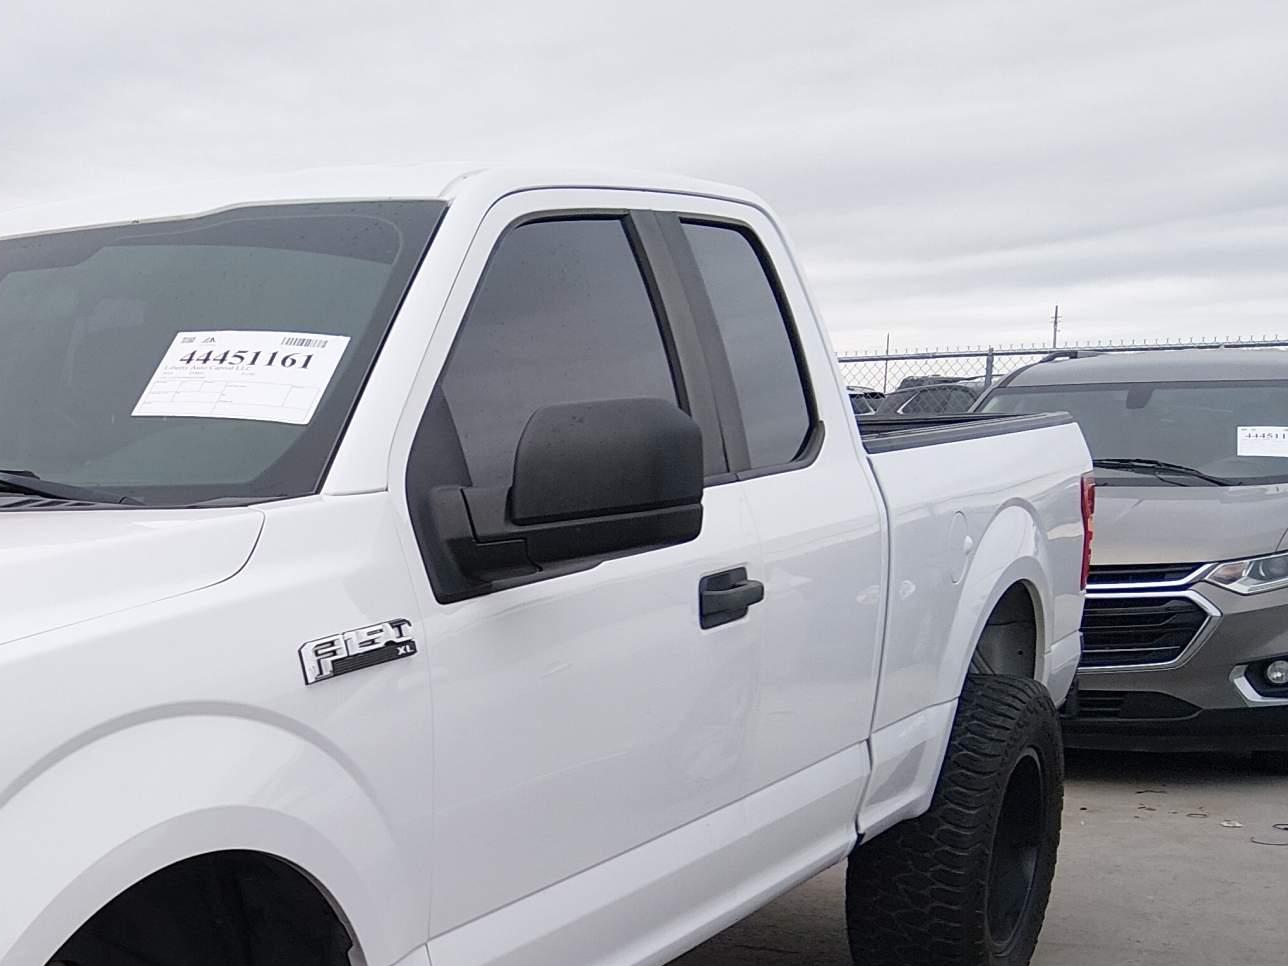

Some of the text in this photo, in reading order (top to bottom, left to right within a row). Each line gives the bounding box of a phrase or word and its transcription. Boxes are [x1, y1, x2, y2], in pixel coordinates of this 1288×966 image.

[179, 350, 314, 369] 44451161
[298, 618, 412, 685] F150
[396, 644, 414, 656] XL
